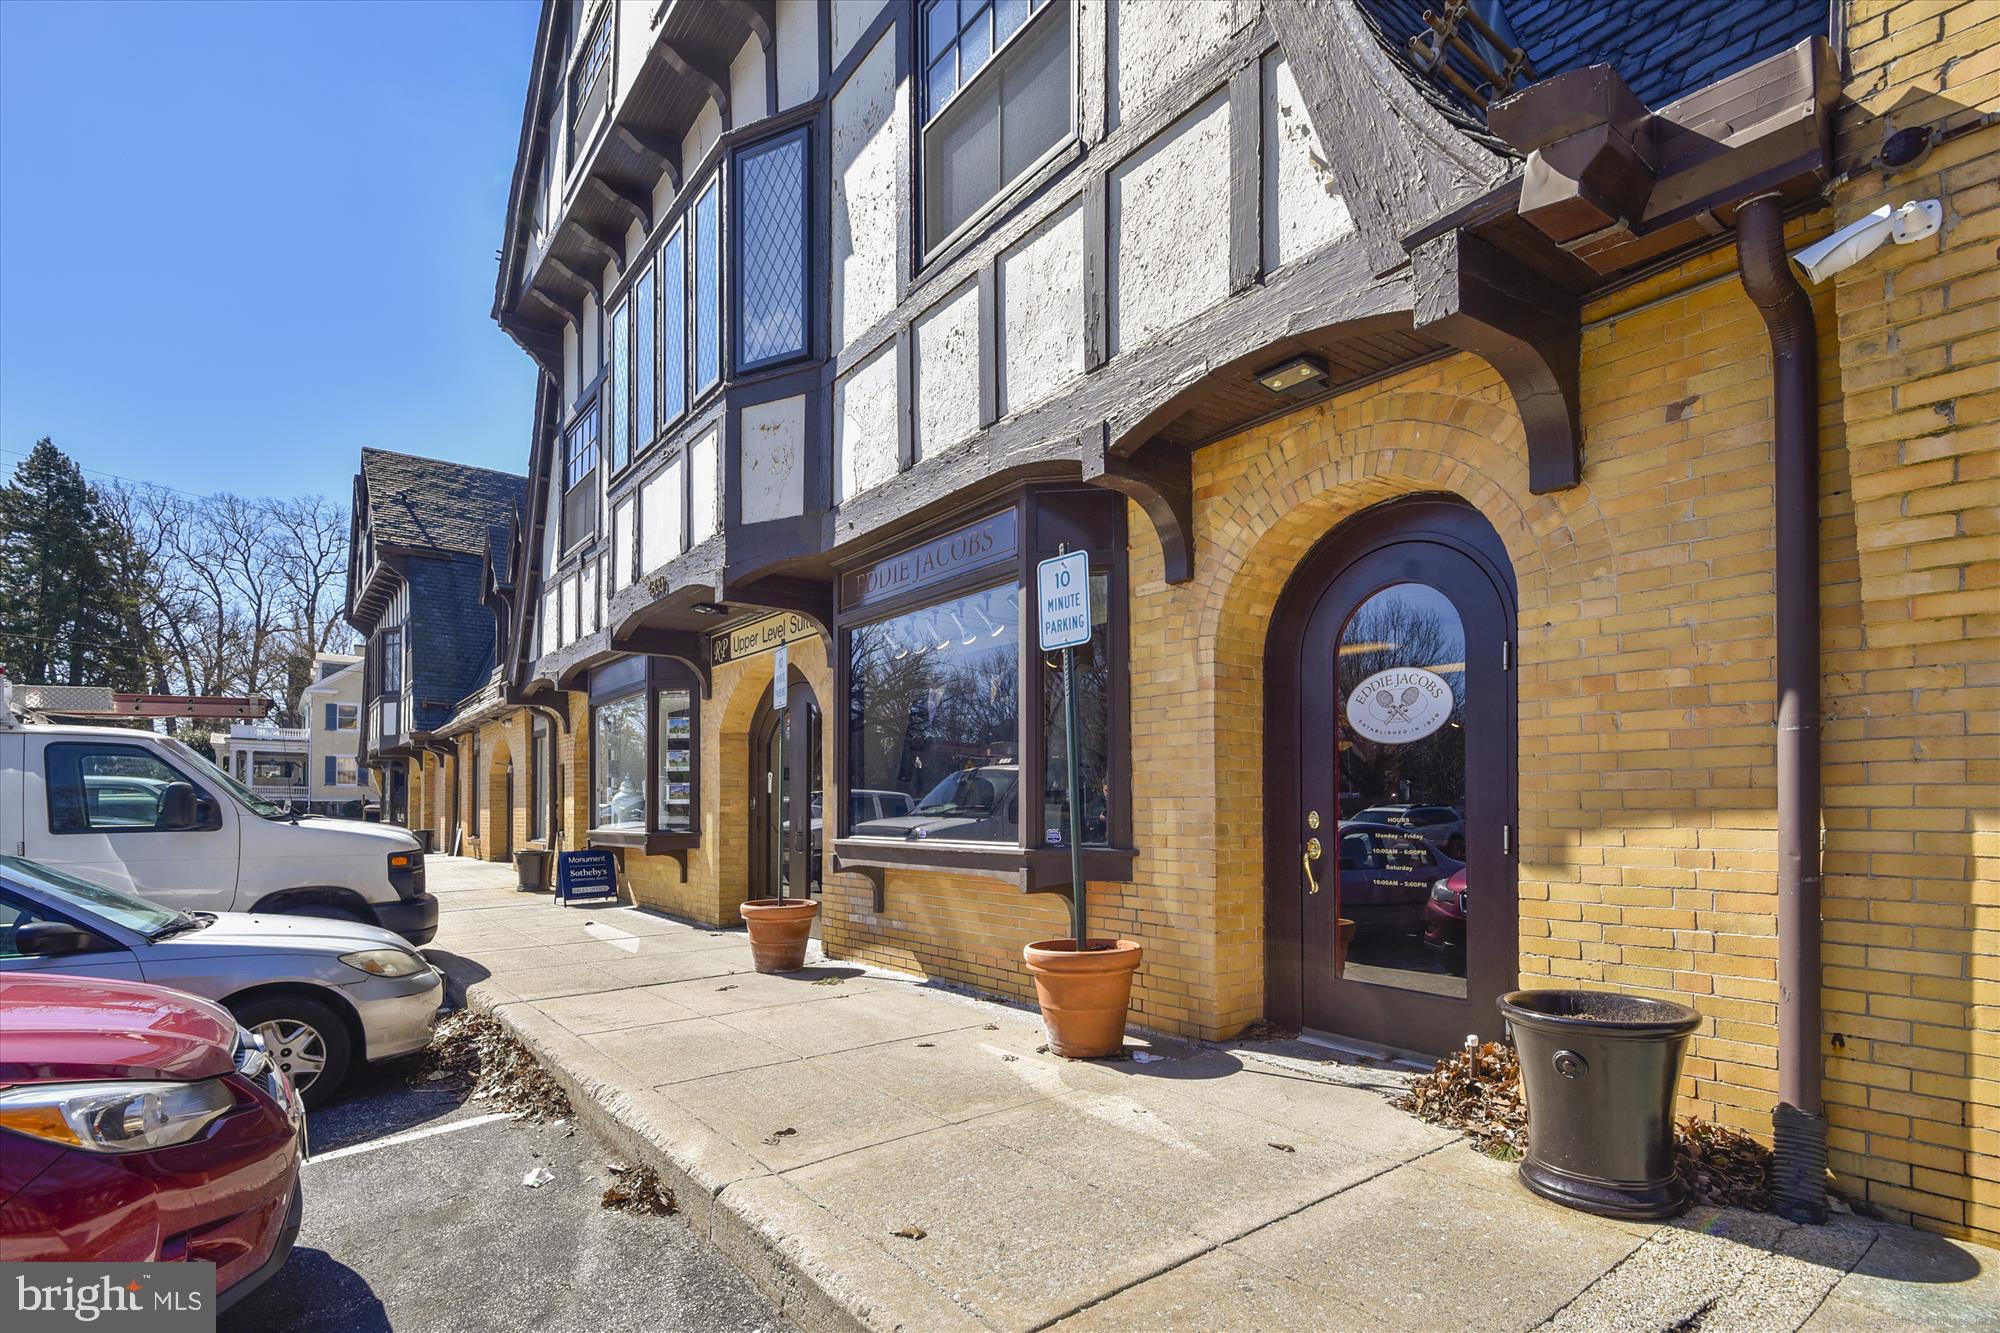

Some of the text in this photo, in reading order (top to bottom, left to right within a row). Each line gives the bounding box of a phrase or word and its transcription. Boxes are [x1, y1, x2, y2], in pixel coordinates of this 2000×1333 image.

[856, 525, 993, 597] EDDIE JACOBS
[1055, 570, 1070, 589] 10
[1047, 592, 1081, 613] MINUTE
[1045, 614, 1085, 635] PARKING
[733, 632, 758, 654] Upper
[762, 619, 786, 643] Level
[1355, 673, 1444, 705] EDDIE JACOBS
[1358, 719, 1408, 735] ESTABLISHED
[1375, 832, 1398, 840] Monday
[1404, 833, 1424, 841] Friday
[568, 856, 606, 864] Monument
[1385, 864, 1413, 873] Saturday
[570, 868, 608, 877] Sotheby's
[1373, 879, 1399, 887] 10:00AM
